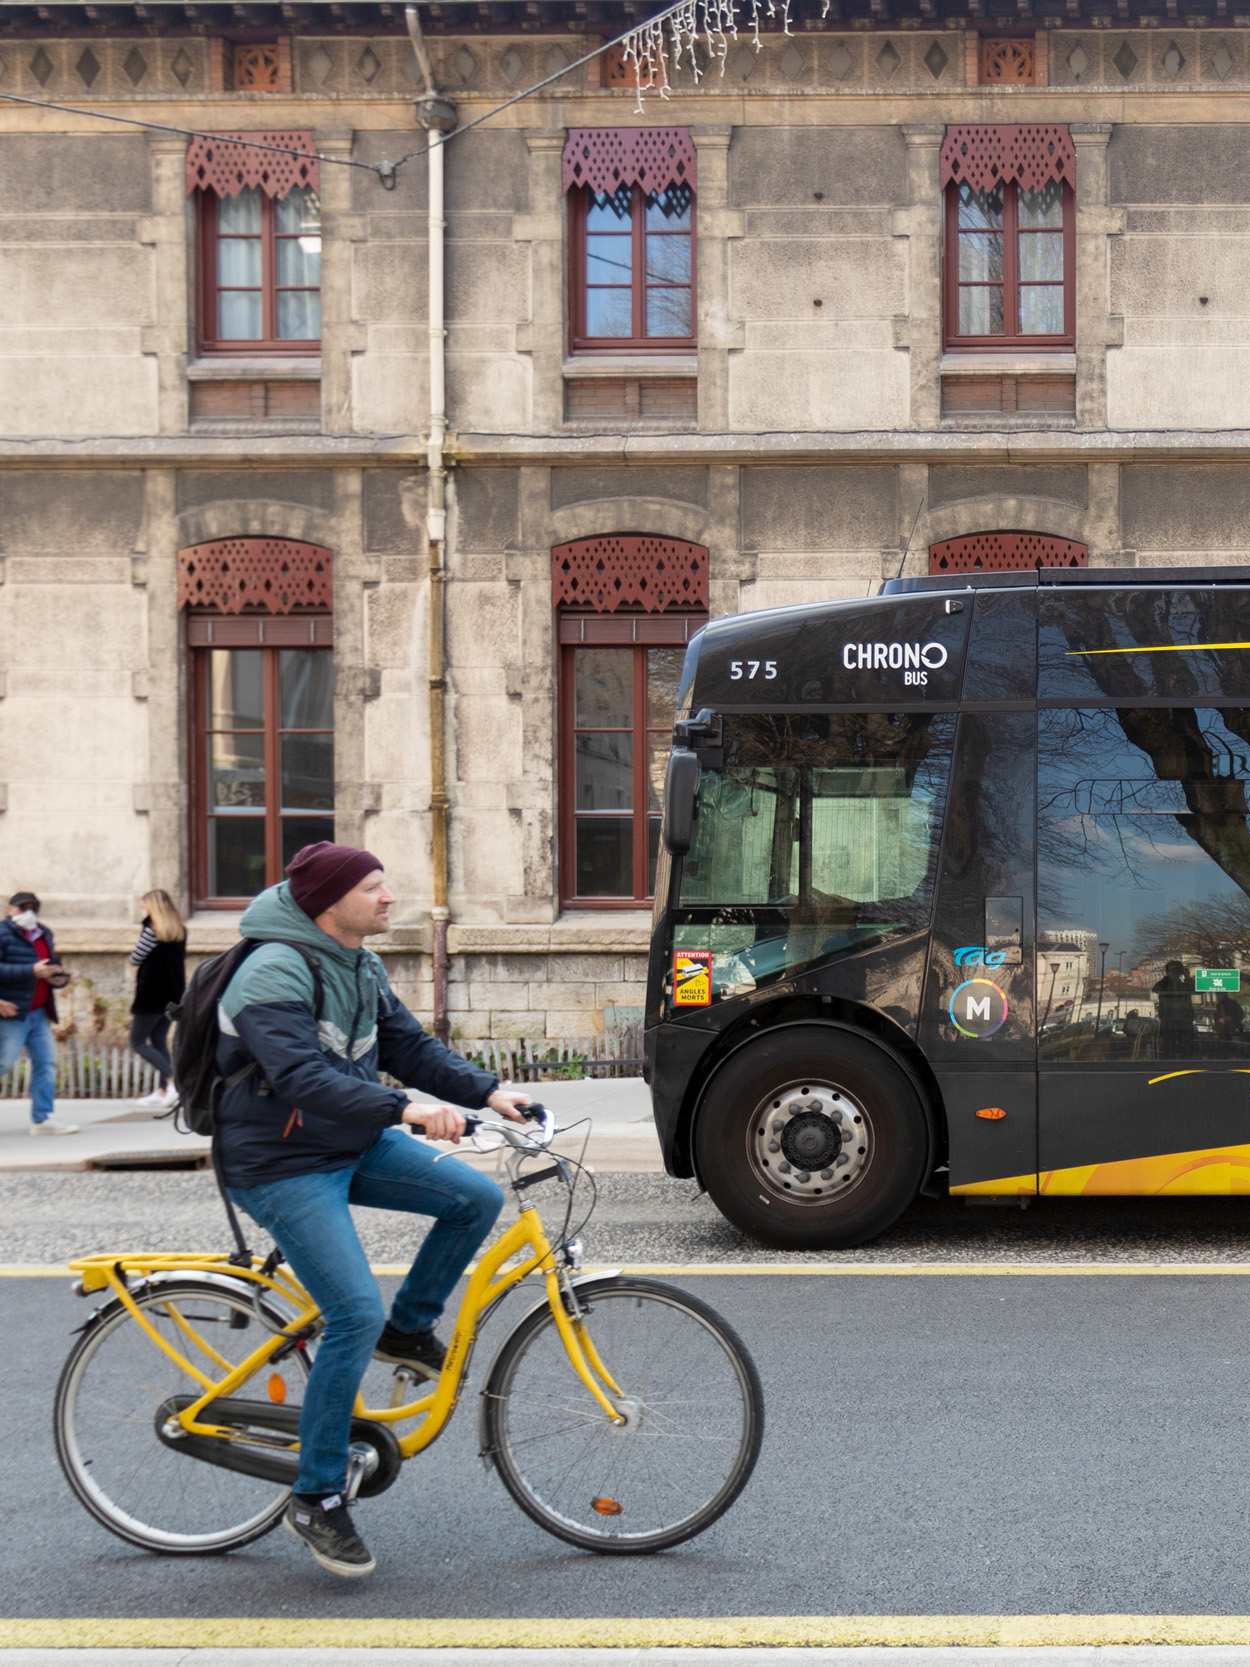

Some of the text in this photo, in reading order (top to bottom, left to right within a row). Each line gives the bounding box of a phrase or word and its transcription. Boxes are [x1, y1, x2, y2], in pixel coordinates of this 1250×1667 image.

[843, 642, 948, 669] CHRONO
[730, 661, 777, 680] 575
[904, 671, 928, 685] BUS
[966, 996, 991, 1021] M
